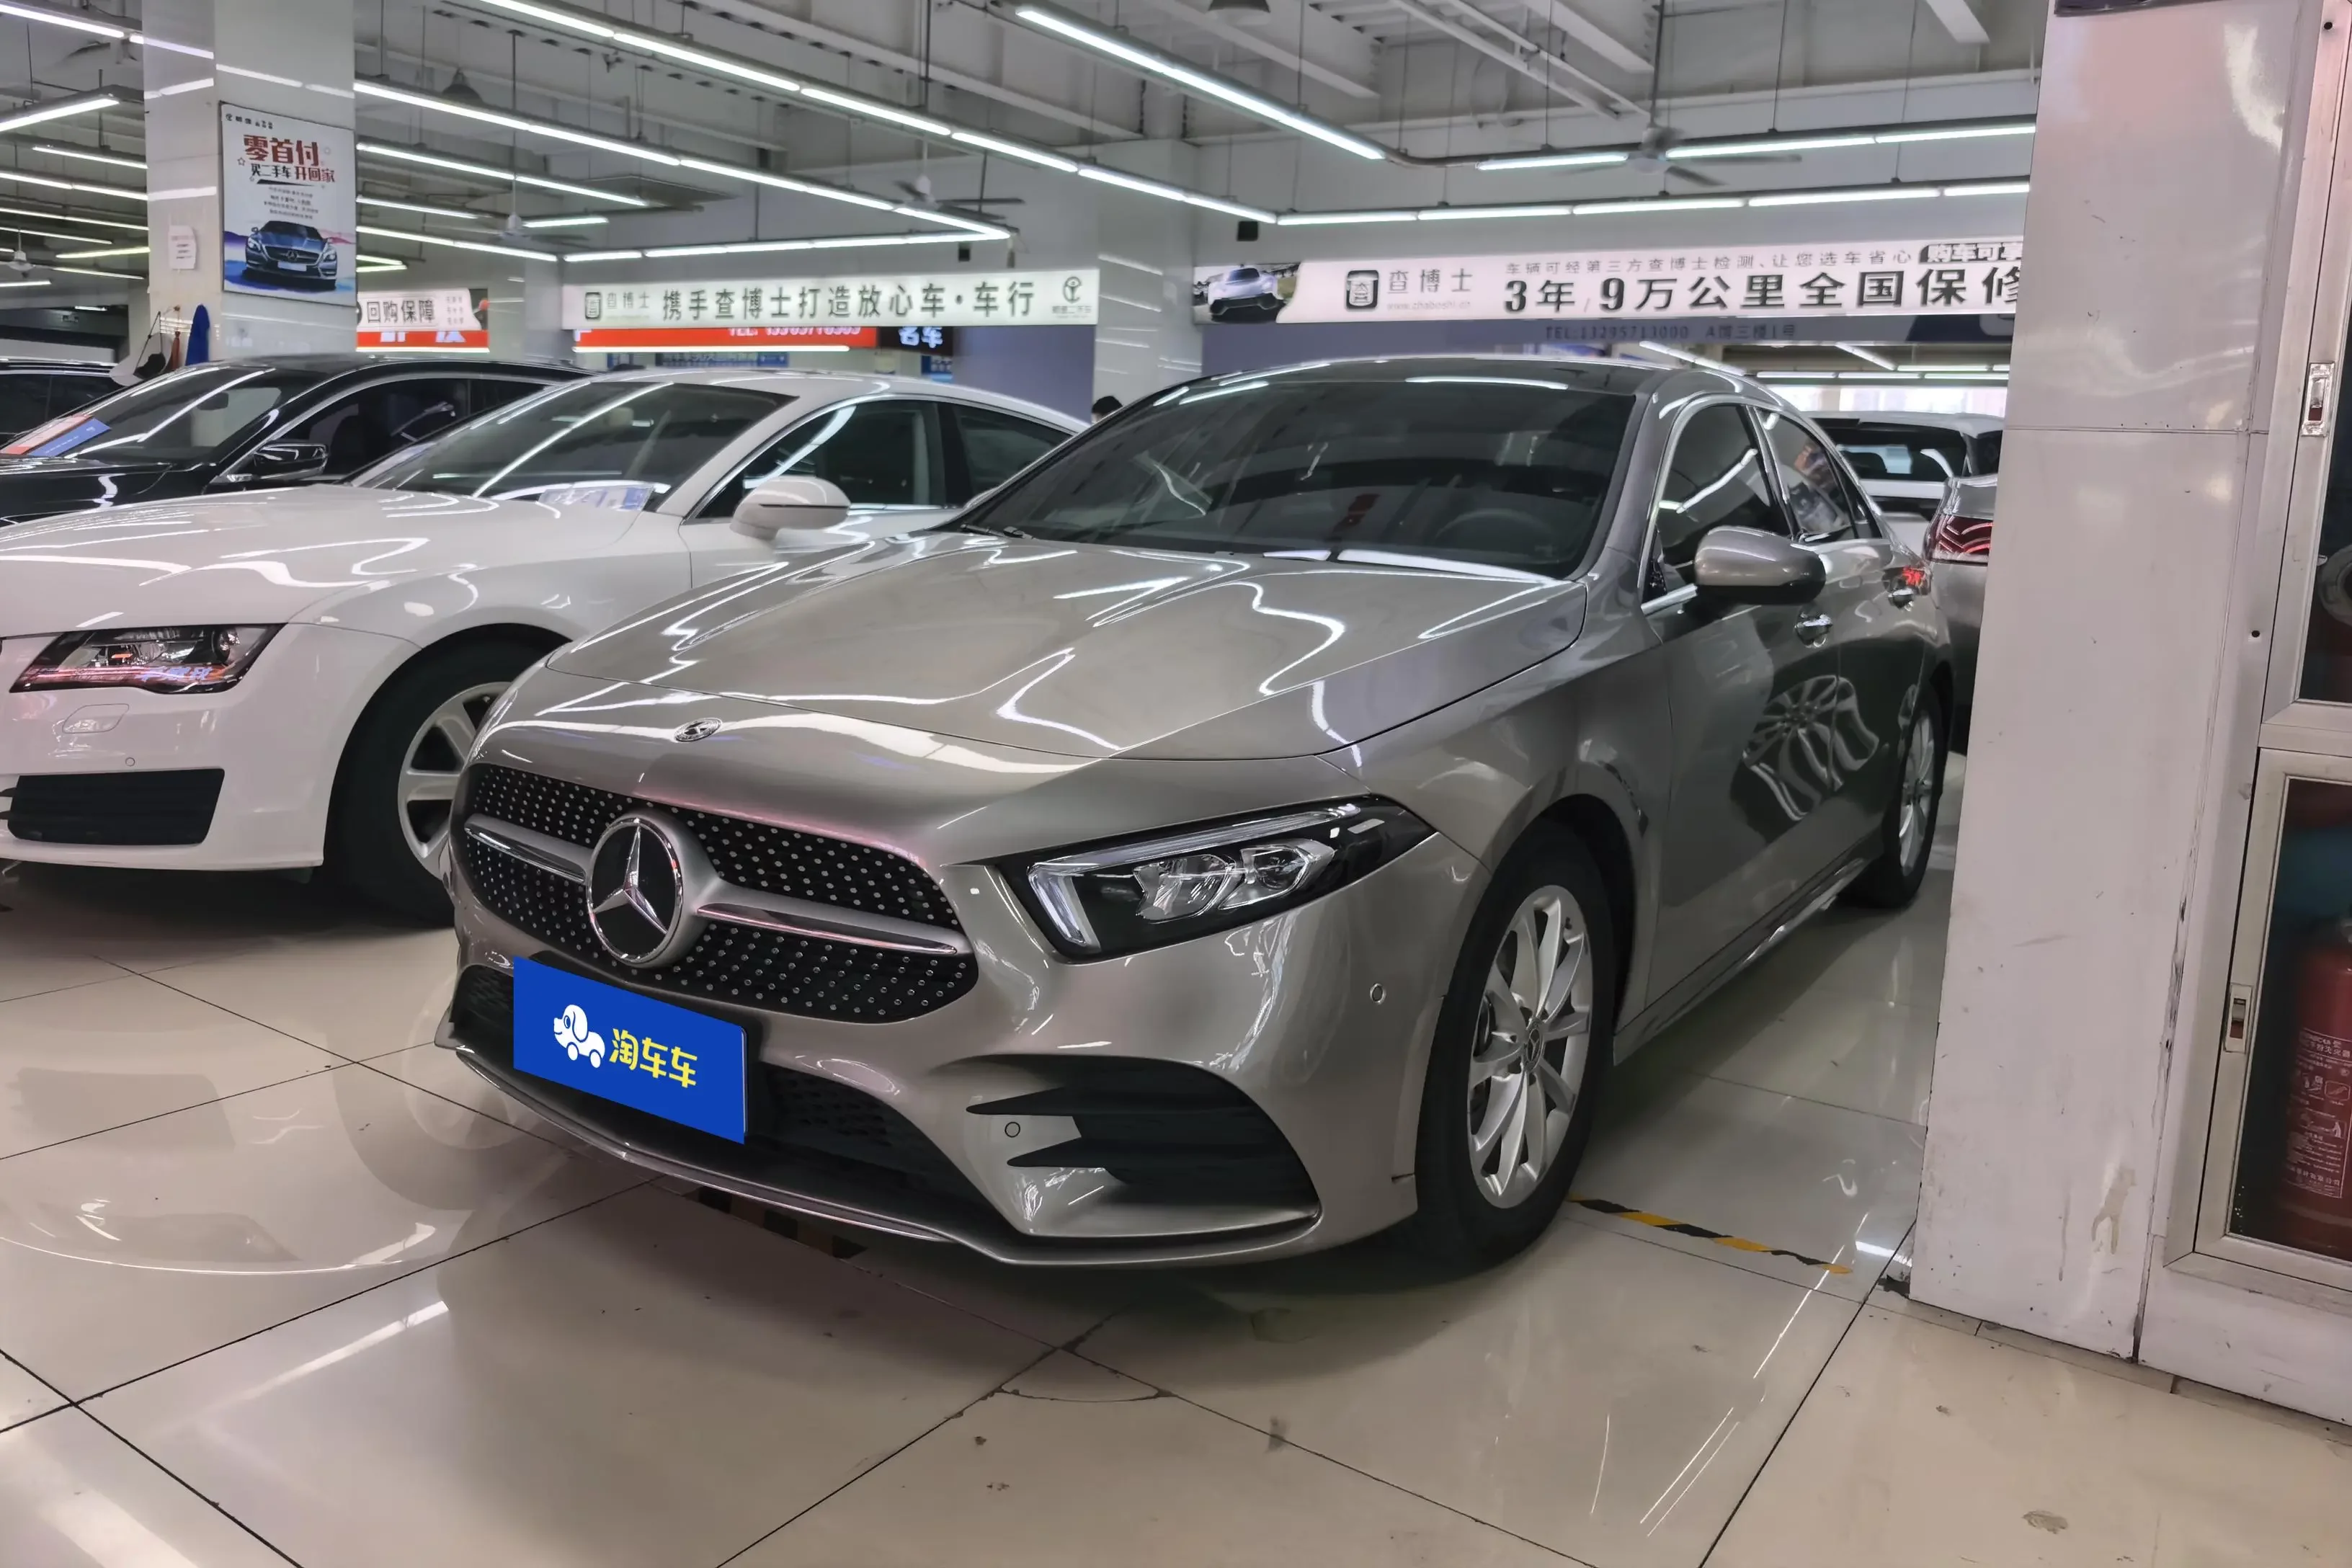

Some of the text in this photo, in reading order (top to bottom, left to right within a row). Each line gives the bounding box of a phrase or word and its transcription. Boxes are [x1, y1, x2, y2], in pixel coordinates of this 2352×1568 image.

[243, 134, 319, 167] 零首付
[1387, 267, 1473, 294] 查博士
[366, 299, 435, 324] 回购保障
[605, 290, 651, 311] 查博士
